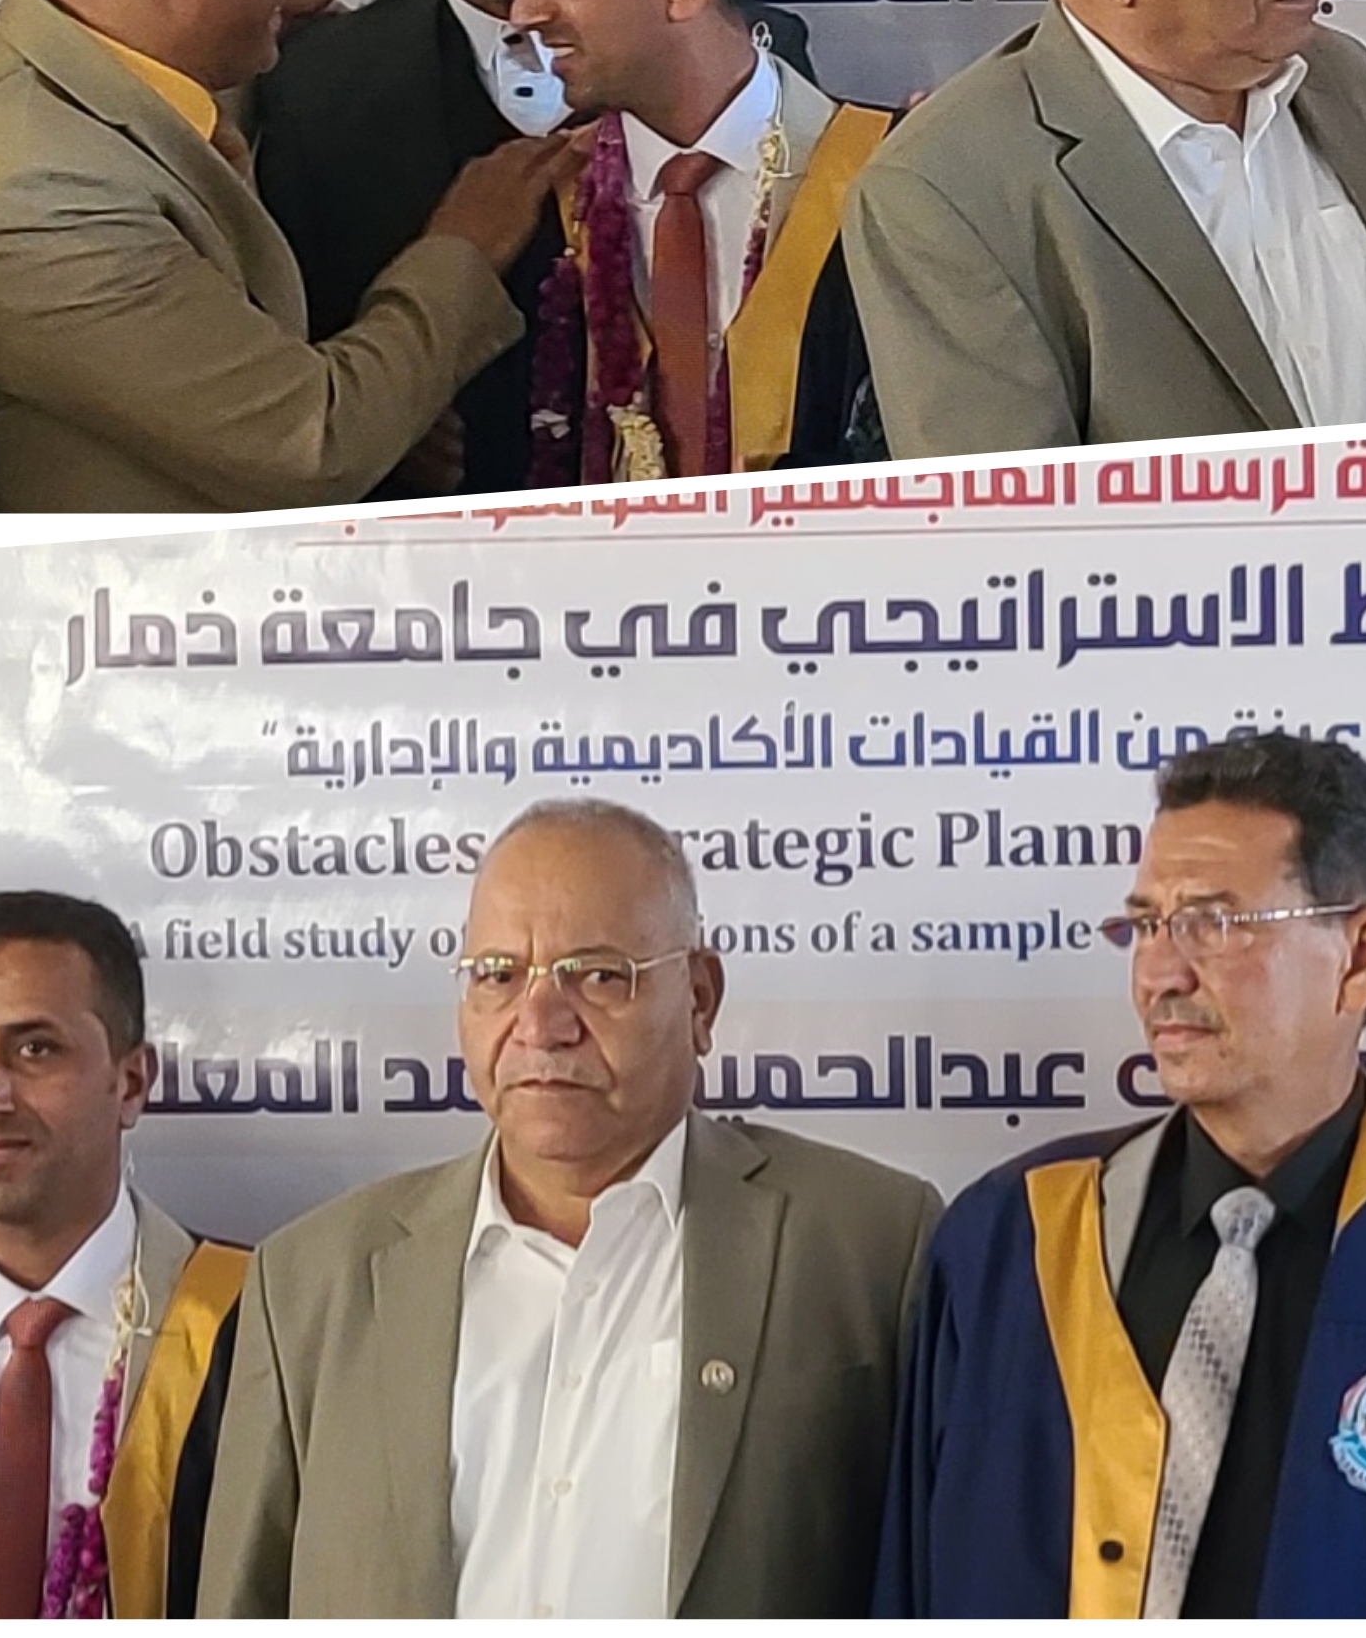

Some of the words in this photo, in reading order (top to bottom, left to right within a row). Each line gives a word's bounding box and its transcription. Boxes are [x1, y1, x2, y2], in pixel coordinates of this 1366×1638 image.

[65, 586, 238, 686] ذمار
[260, 579, 541, 681] جامعة
[563, 581, 737, 678] في
[760, 562, 1305, 677] الاستراتيجي
[286, 718, 517, 791] والإدارية
[532, 700, 833, 785] الأكاديمية
[848, 709, 1100, 779] القيادات
[150, 817, 485, 880] Obstacles
[678, 811, 915, 887] rategic
[936, 808, 1143, 869] Plann
[164, 917, 271, 961] field
[283, 916, 416, 970] study
[429, 925, 468, 960] o
[809, 910, 863, 955] of
[869, 921, 897, 954] a
[910, 908, 1093, 962] sample
